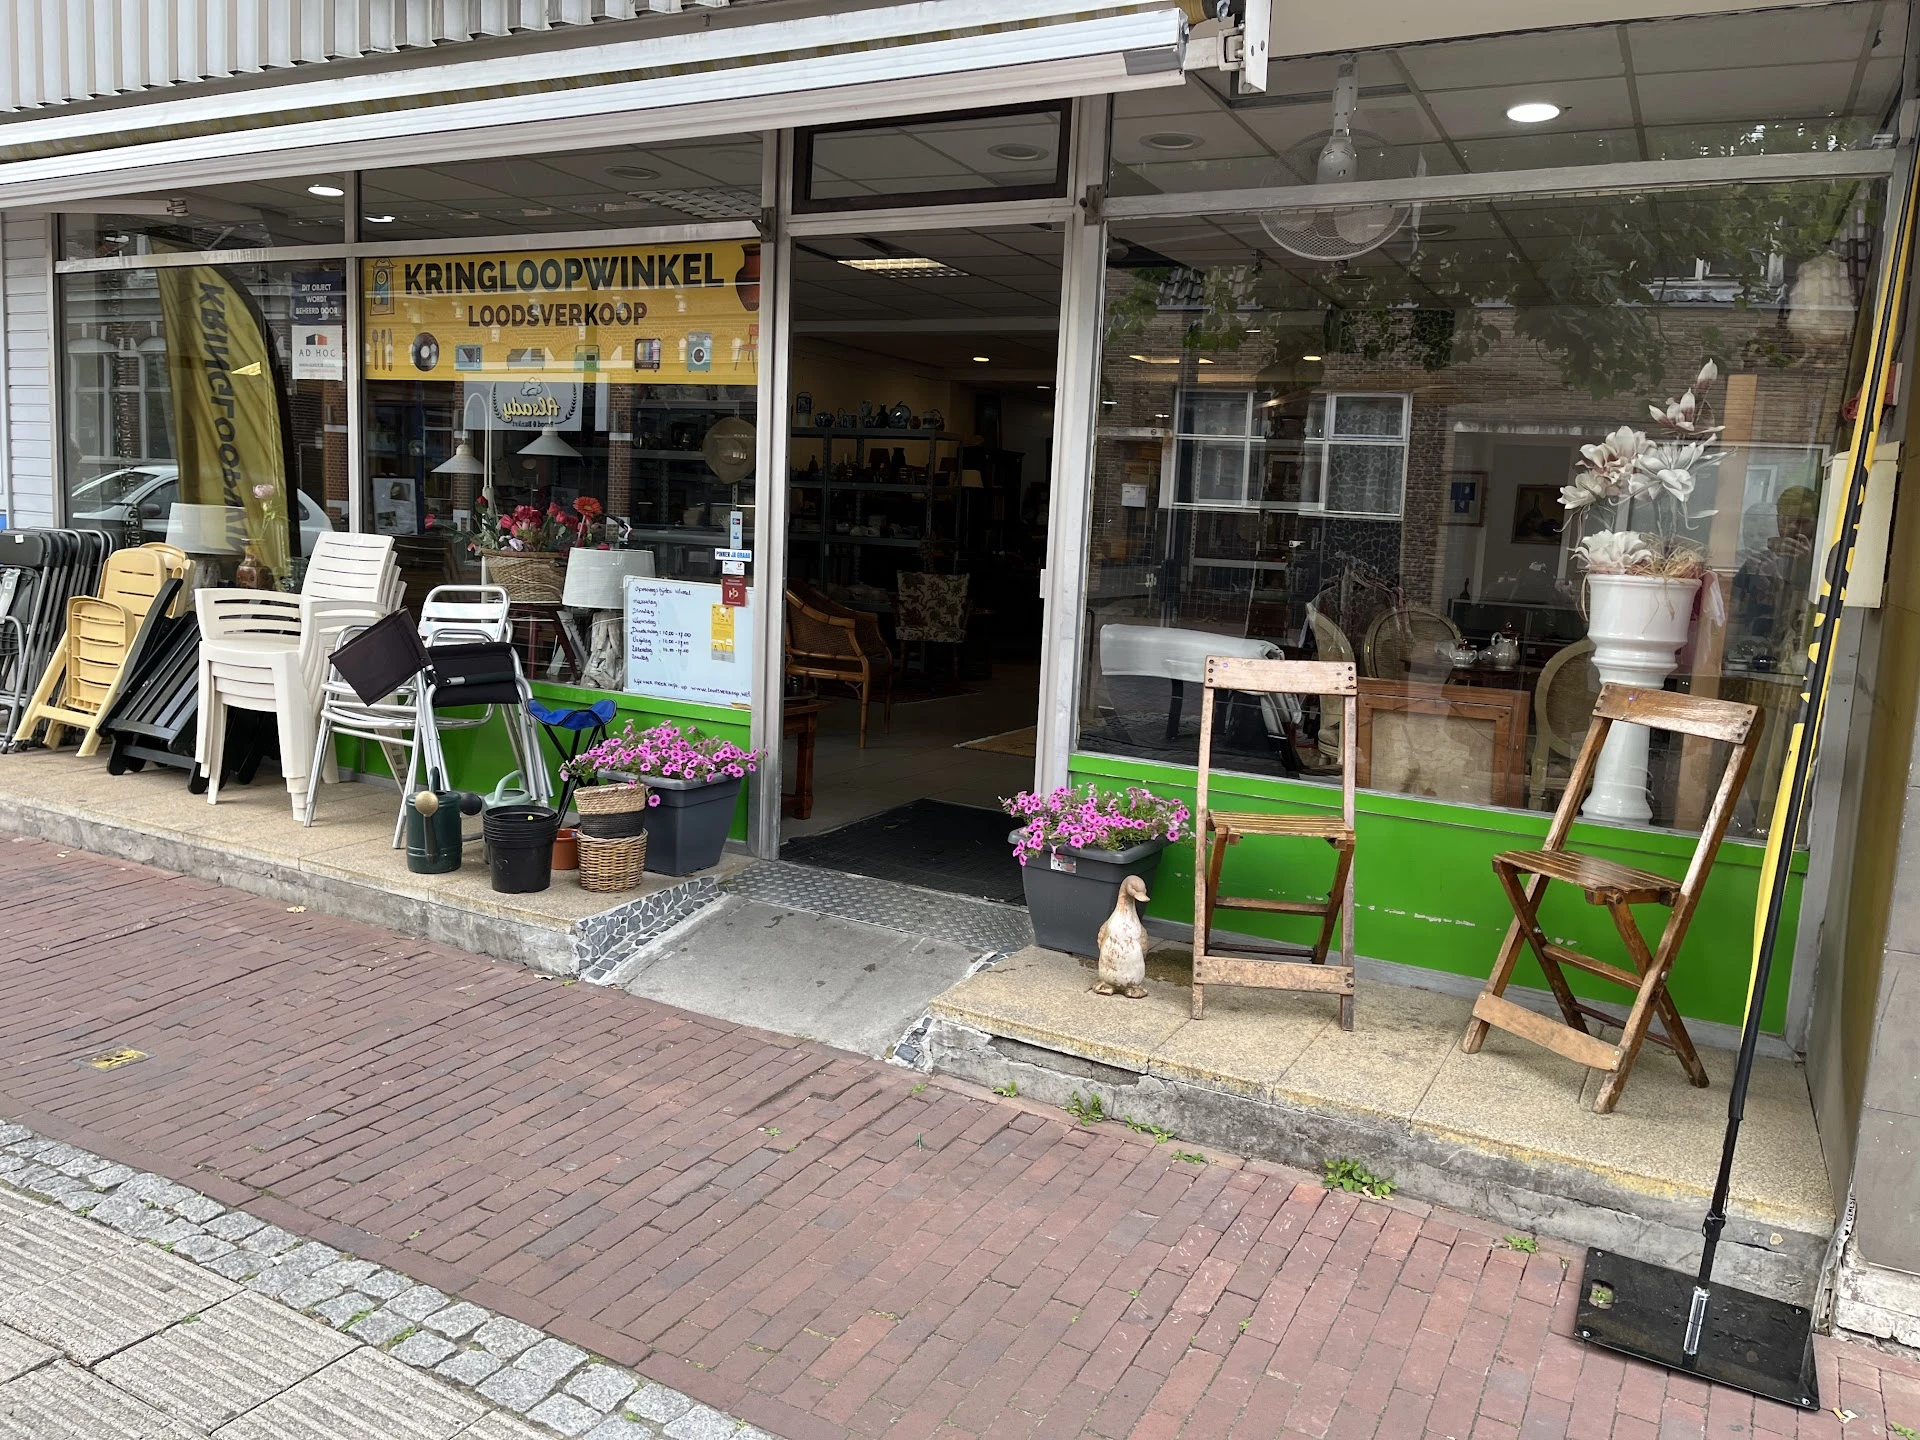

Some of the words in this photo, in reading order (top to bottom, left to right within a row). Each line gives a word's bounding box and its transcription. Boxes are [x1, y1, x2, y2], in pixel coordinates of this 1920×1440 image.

[404, 252, 725, 294] KRINGLOOPWINKEL
[301, 283, 310, 292] DIT
[311, 283, 332, 292] OBJECT
[305, 295, 327, 303] WORDT
[295, 307, 319, 315] BEHEERD
[467, 302, 648, 327] LOODSVERKOOP
[298, 348, 311, 357] AD
[315, 348, 336, 358] HOC
